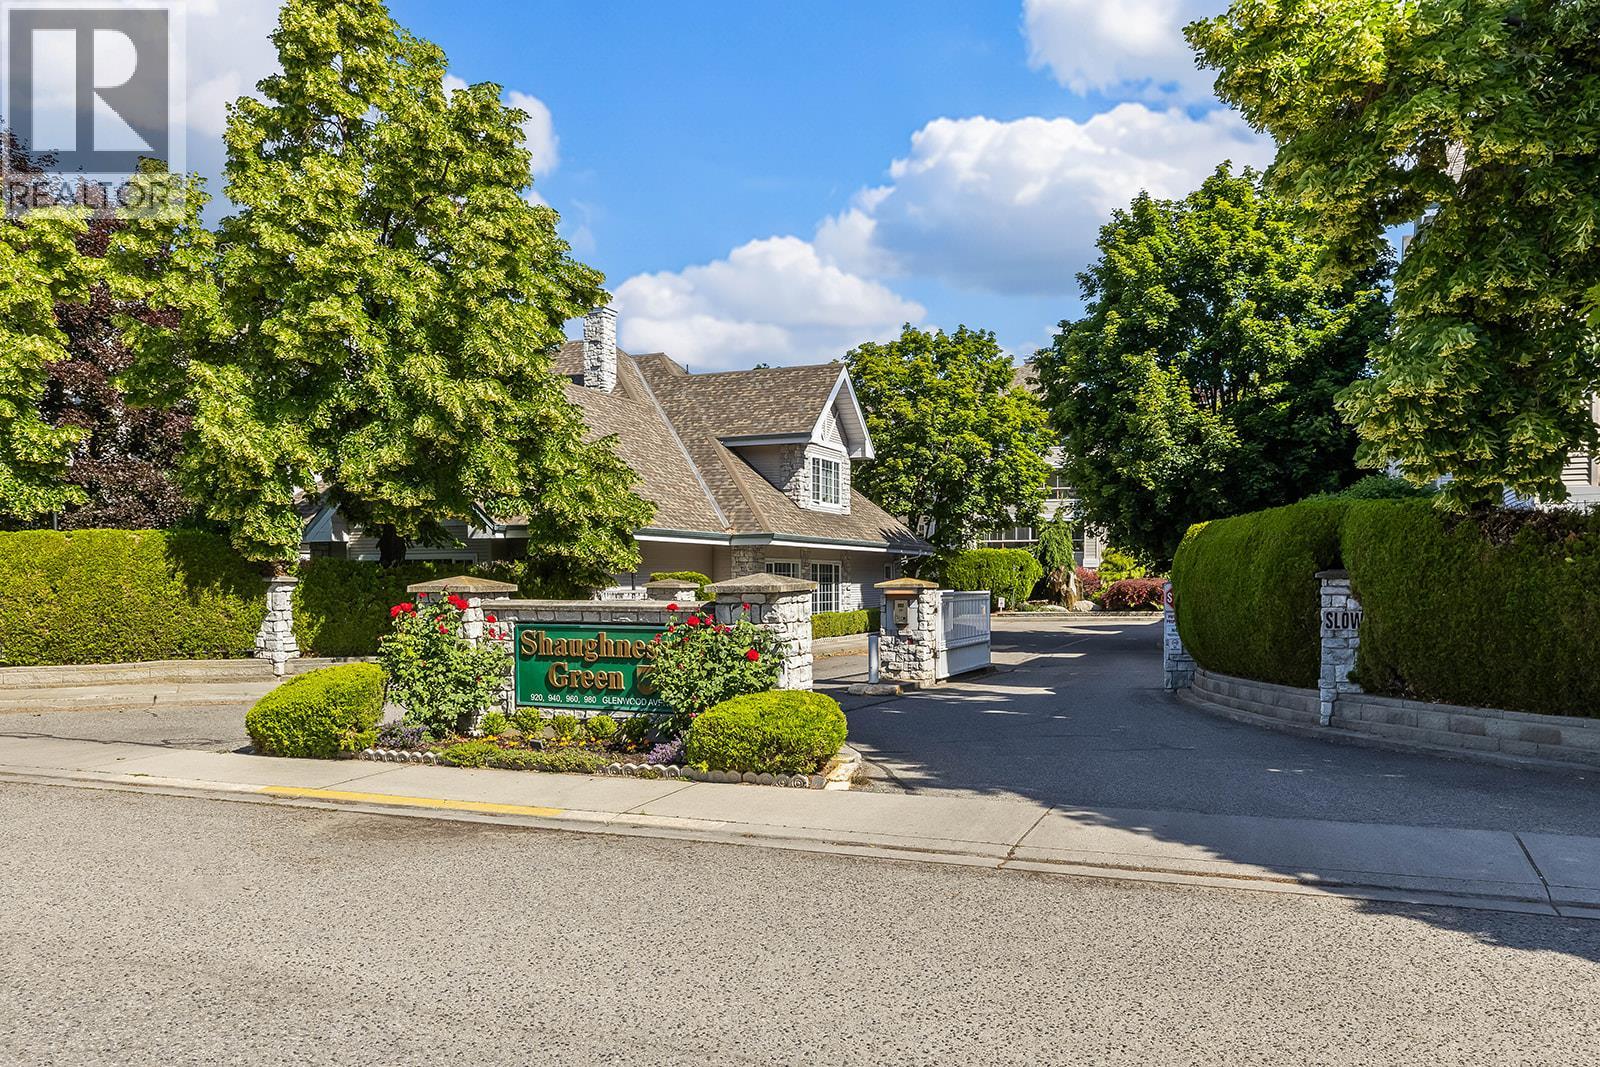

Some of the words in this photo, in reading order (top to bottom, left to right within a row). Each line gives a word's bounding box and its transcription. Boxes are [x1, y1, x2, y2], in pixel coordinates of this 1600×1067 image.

[1325, 611, 1363, 629] SLOW
[520, 629, 660, 662] Shaughnes
[548, 661, 625, 690] Green
[530, 693, 545, 702] 920,
[547, 694, 563, 703] 940,
[565, 695, 580, 704] 960,
[583, 696, 597, 704] 980
[602, 696, 647, 706] GLENWOOD
